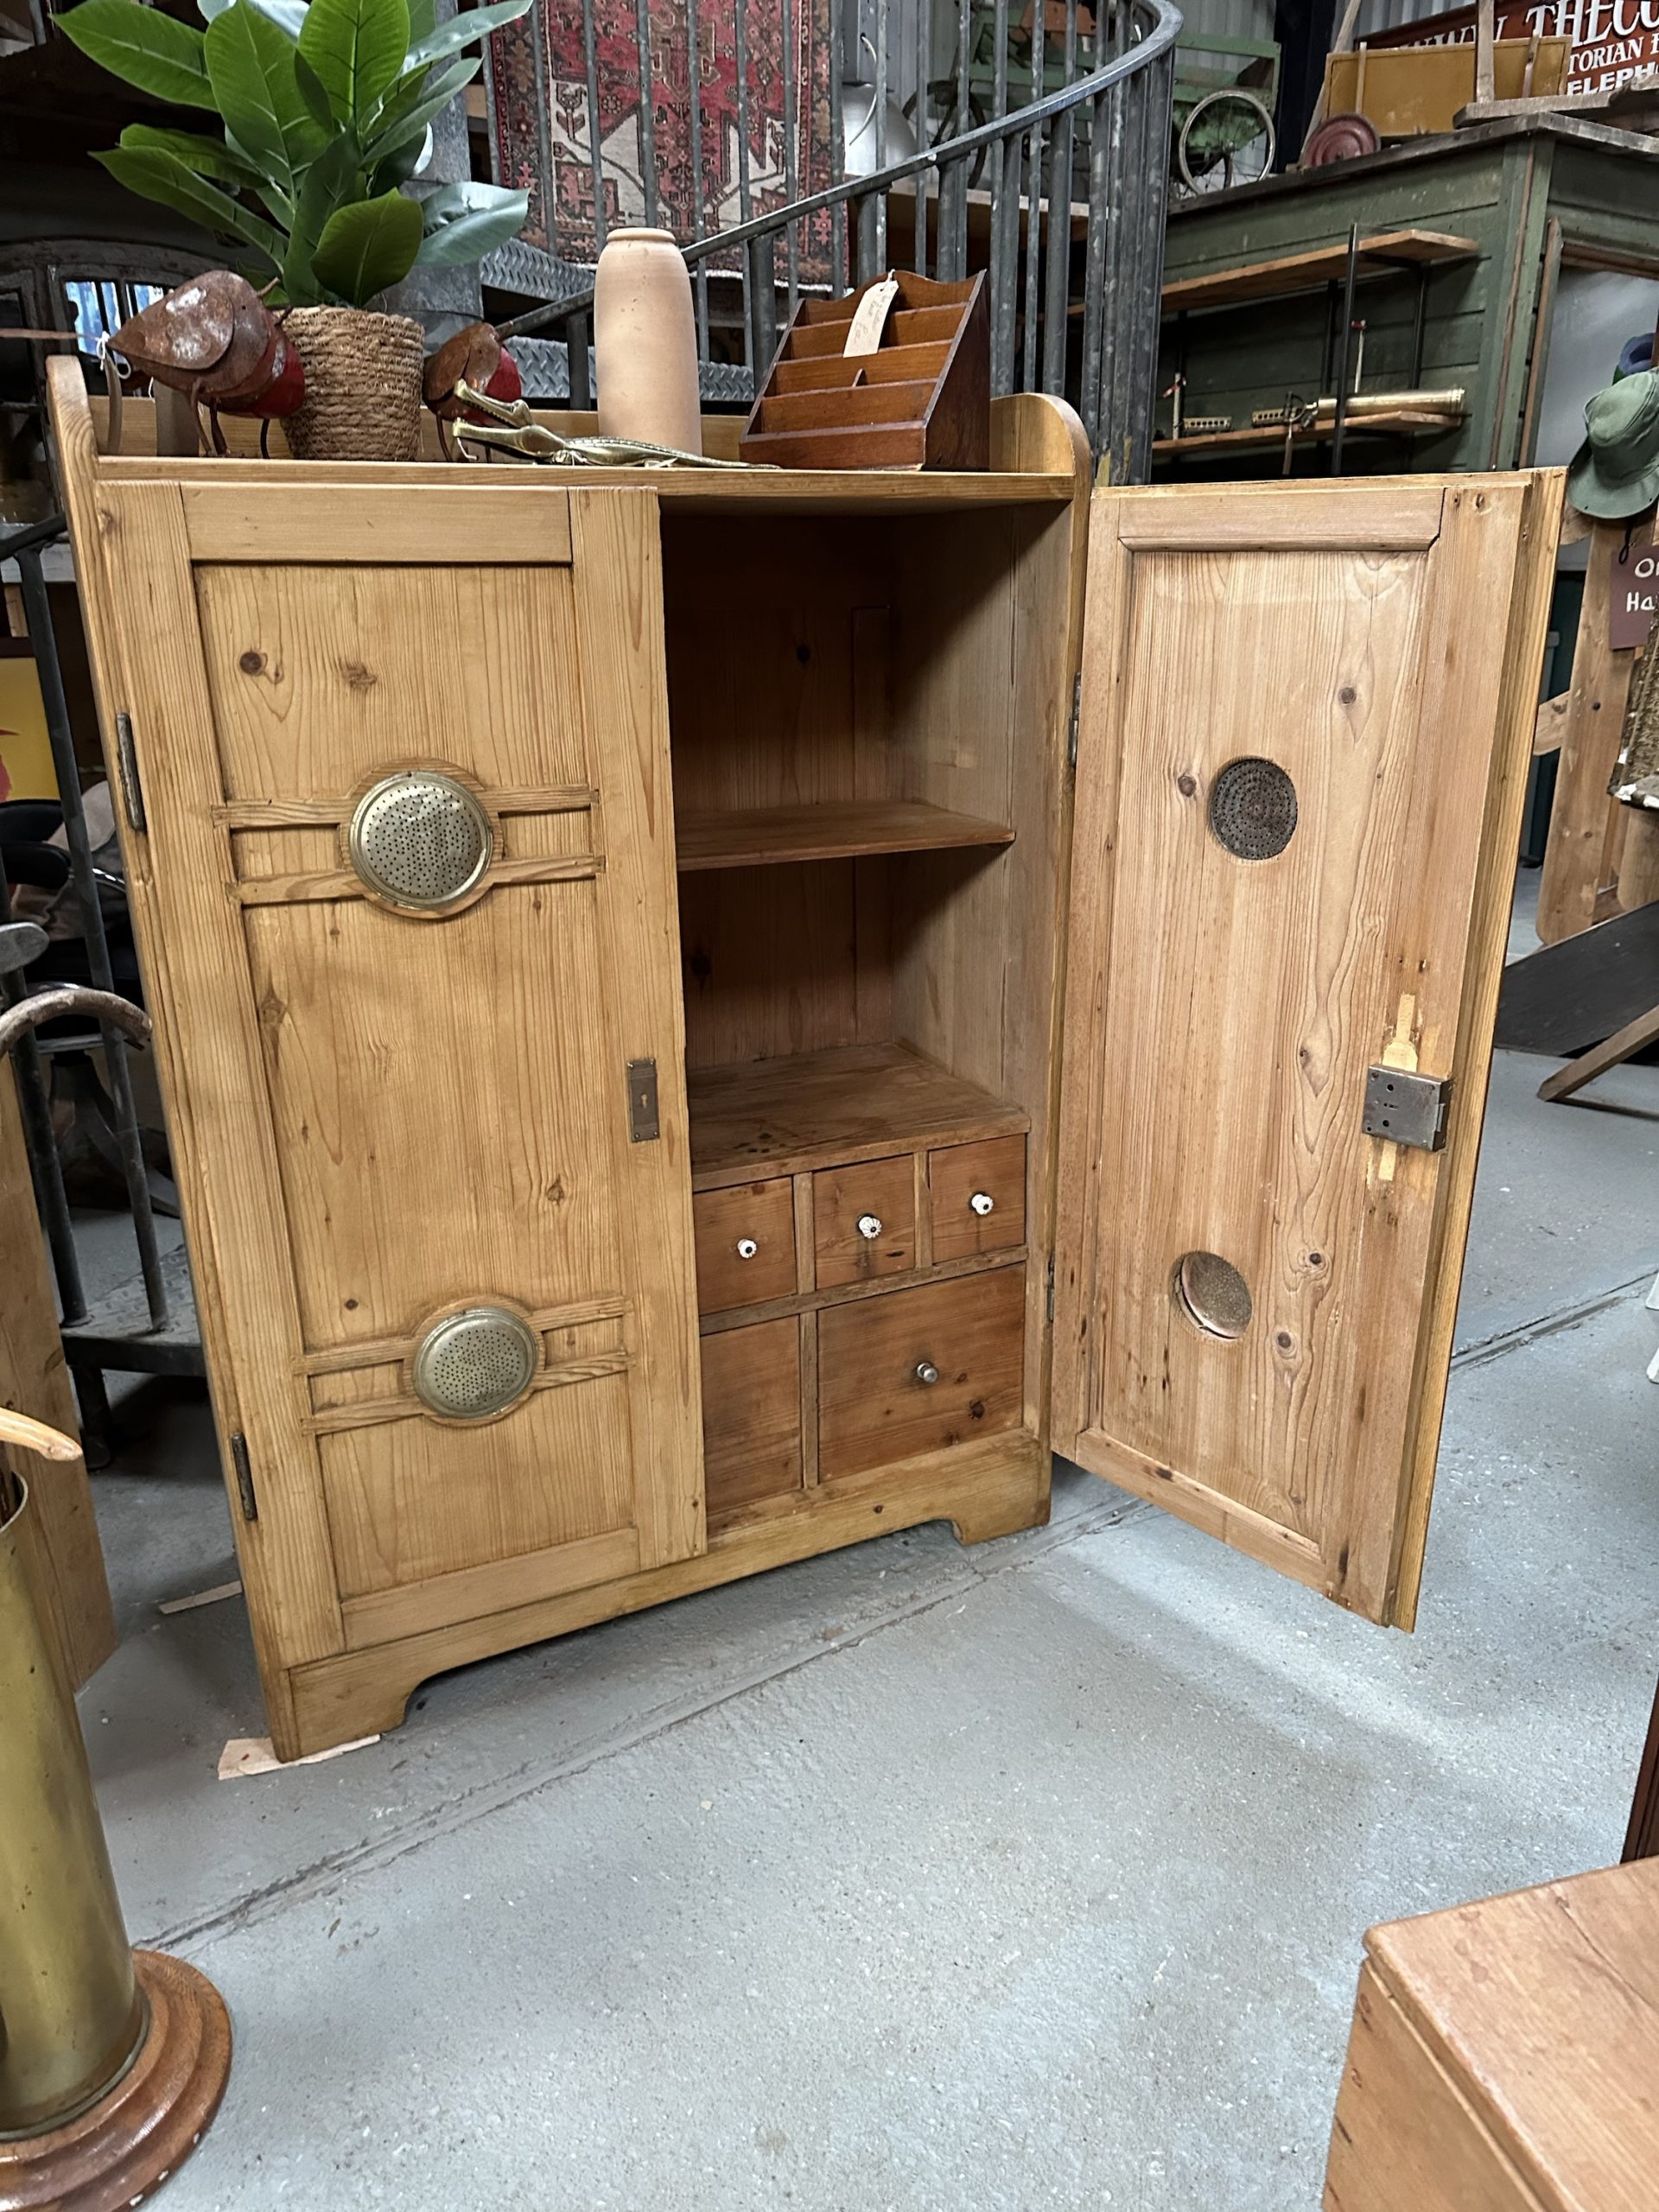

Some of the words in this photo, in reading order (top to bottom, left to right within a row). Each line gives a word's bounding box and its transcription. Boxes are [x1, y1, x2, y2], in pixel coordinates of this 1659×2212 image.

[1567, 36, 1644, 75] TORIAN
[1567, 61, 1659, 96] ELEPH
[1626, 591, 1657, 613] Ha
